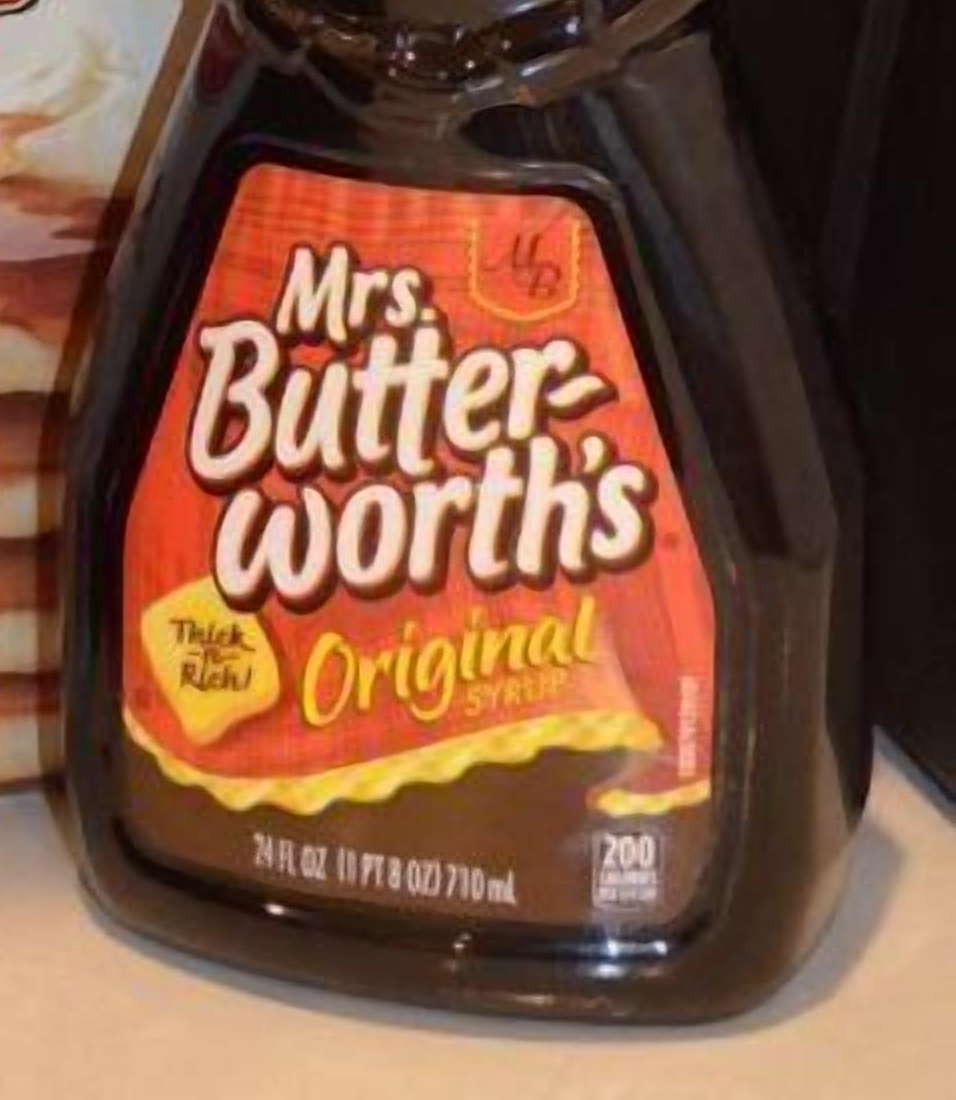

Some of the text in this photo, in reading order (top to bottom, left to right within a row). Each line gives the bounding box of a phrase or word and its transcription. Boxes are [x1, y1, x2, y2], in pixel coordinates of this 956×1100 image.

[274, 244, 439, 343] Mrs.
[189, 320, 620, 484] Butter-
[215, 432, 648, 600] worth's
[169, 617, 256, 651] Thick
[302, 596, 596, 727] Original
[464, 669, 568, 716] SYRUP
[602, 831, 657, 869] 200
